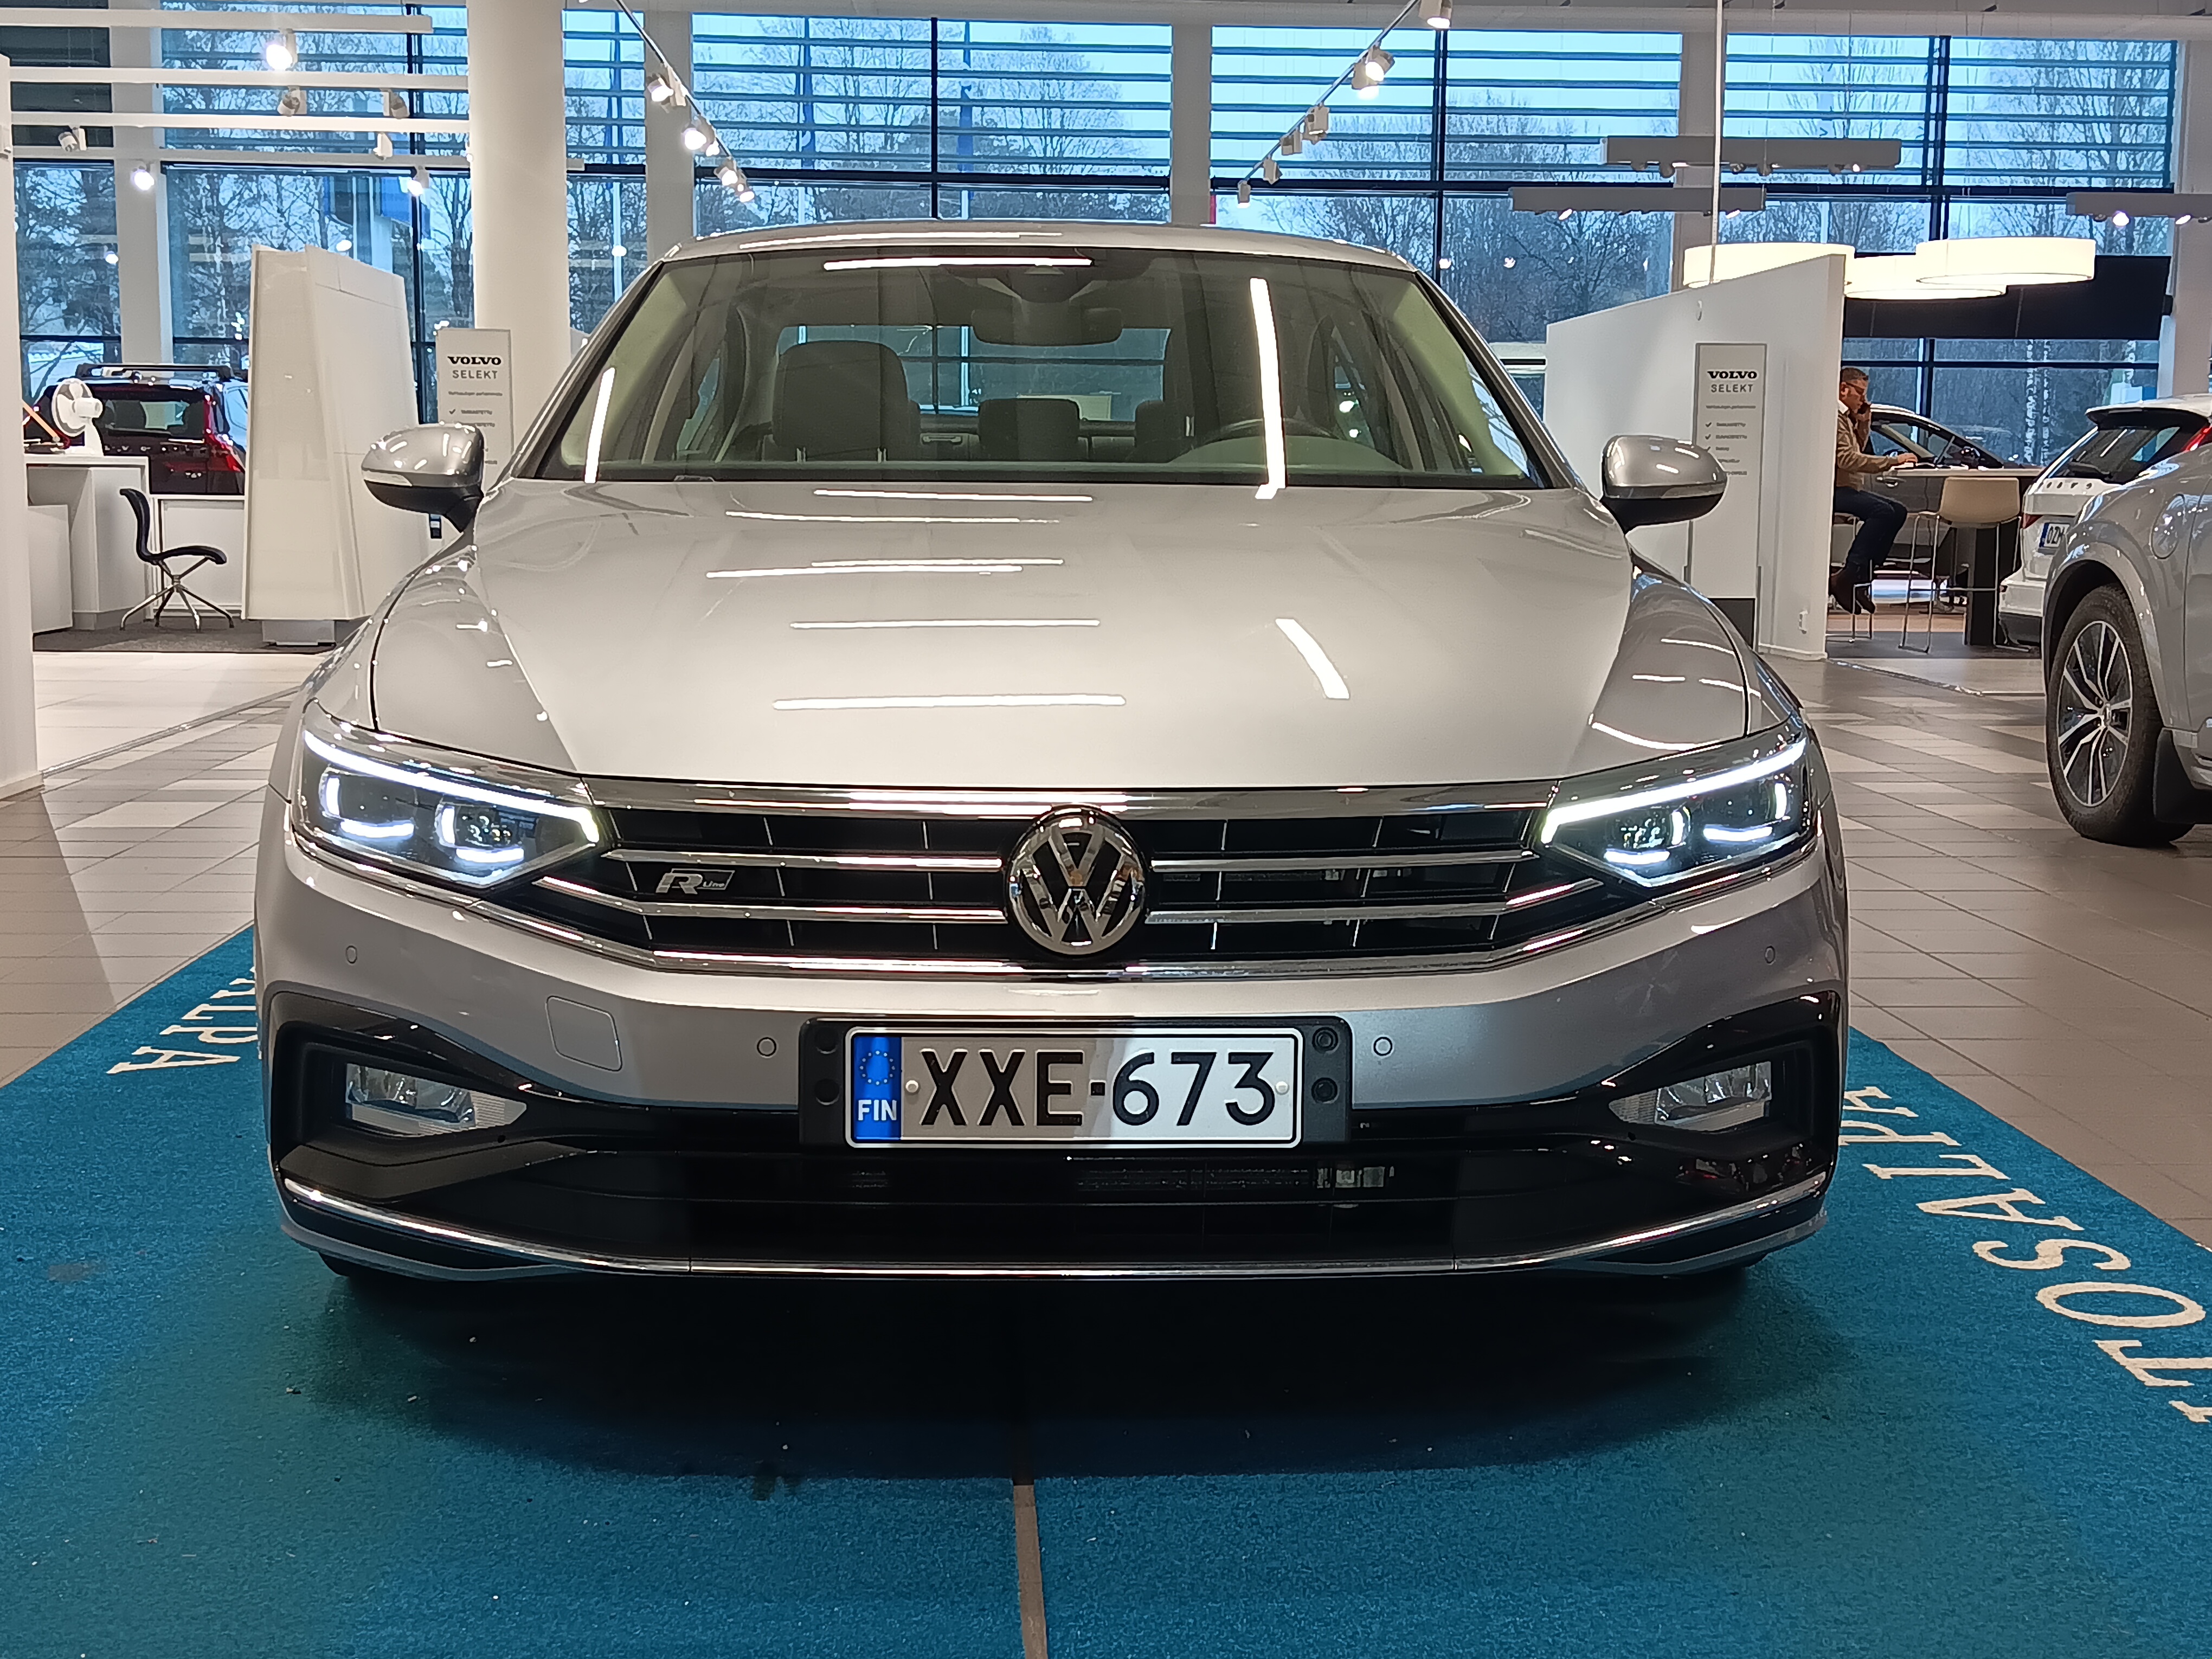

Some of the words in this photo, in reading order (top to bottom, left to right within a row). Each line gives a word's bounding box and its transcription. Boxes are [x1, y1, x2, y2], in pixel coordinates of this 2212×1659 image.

[447, 356, 501, 365] VOLVO
[452, 370, 498, 379] SELEKT
[1707, 371, 1757, 379] VOLVO
[1711, 383, 1753, 393] SELEKT
[920, 1049, 1275, 1126] XXE-673
[858, 1099, 897, 1121] FIN
